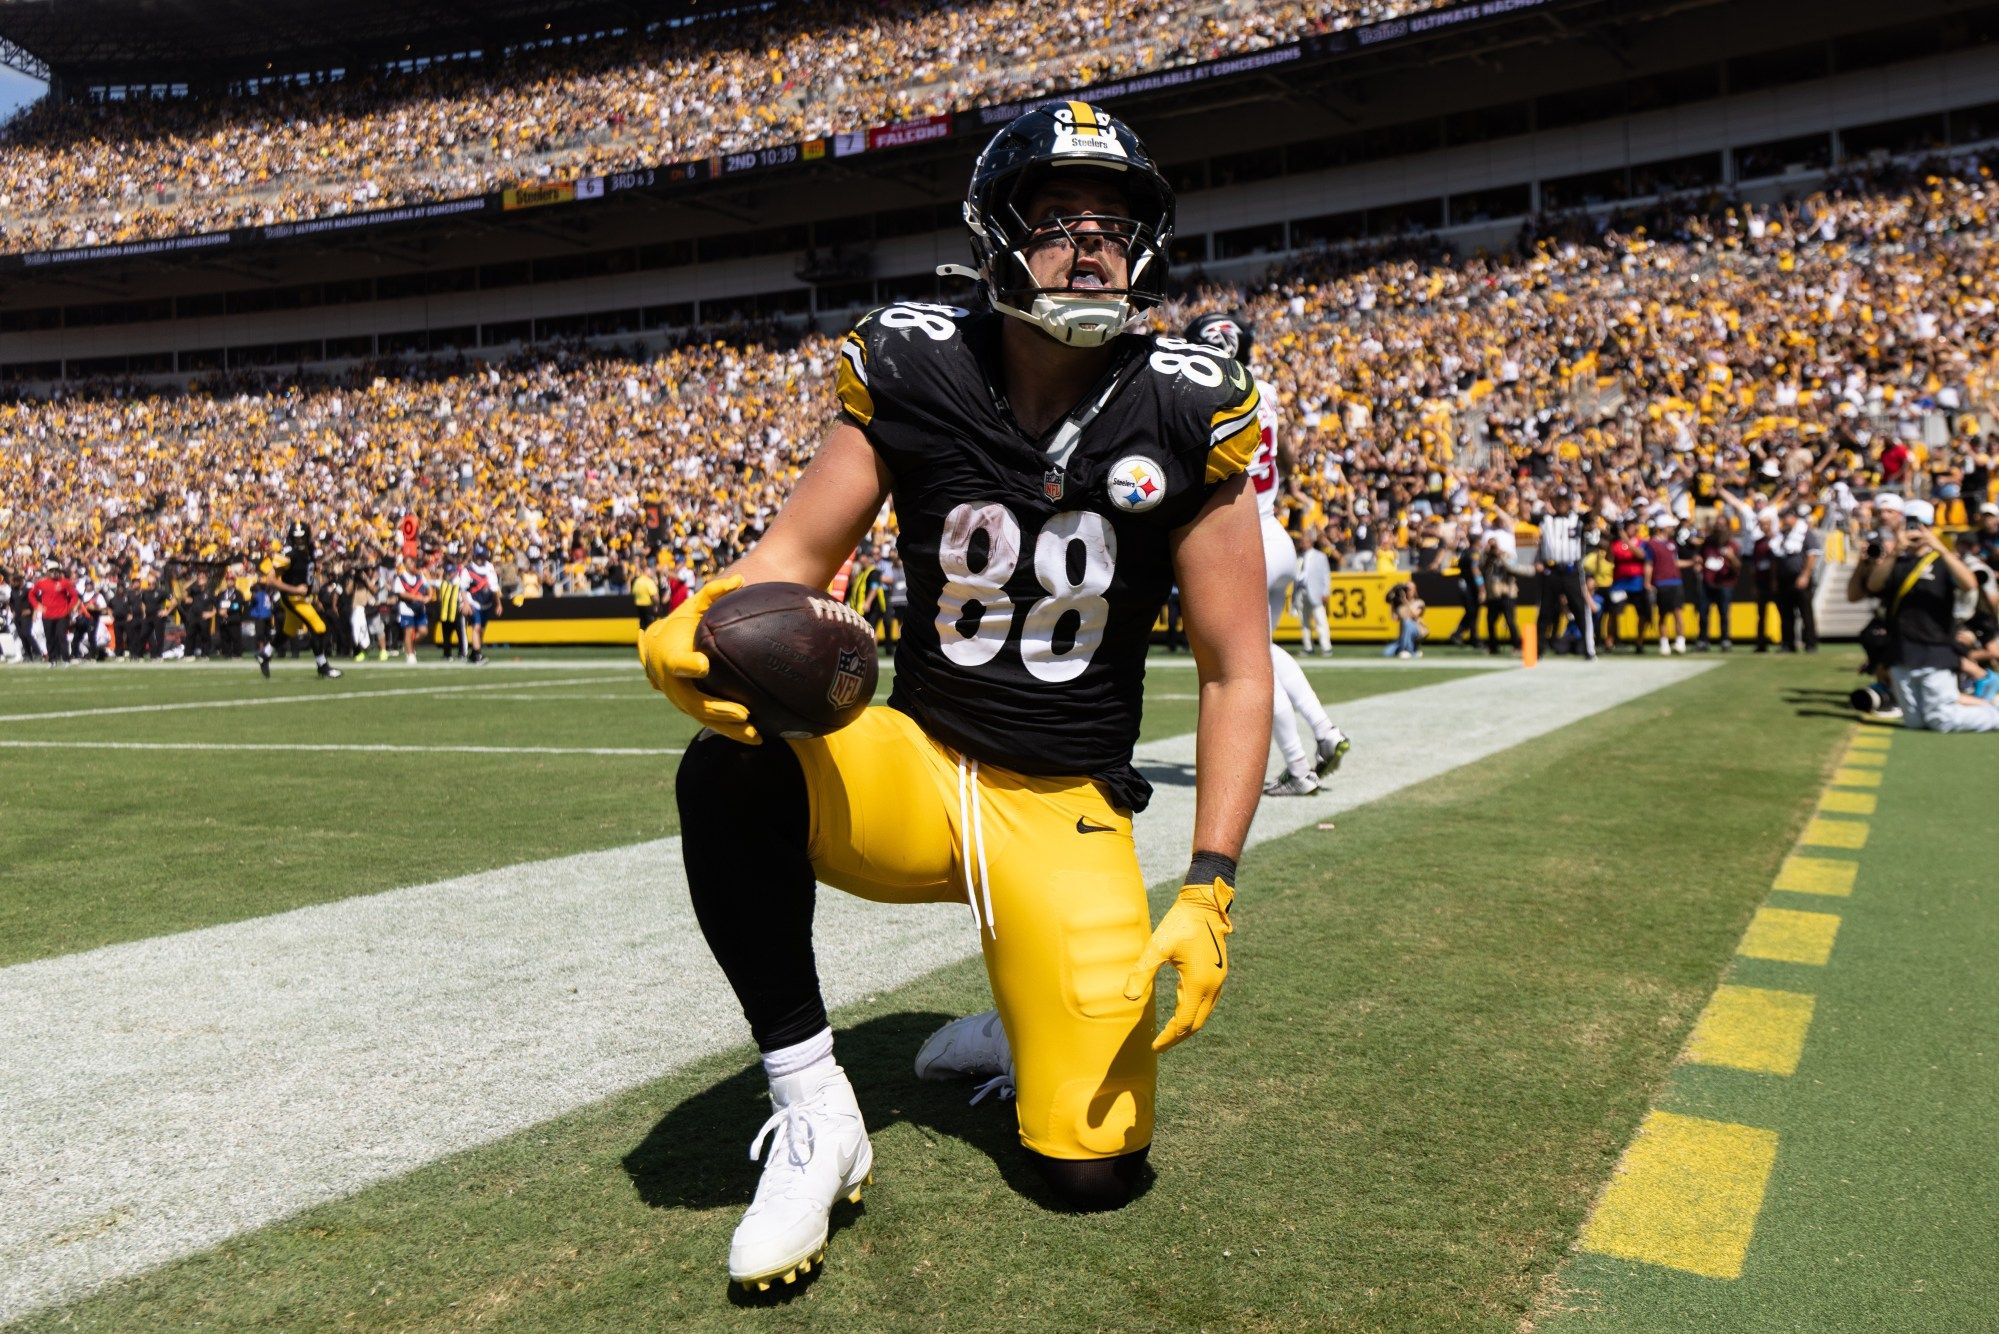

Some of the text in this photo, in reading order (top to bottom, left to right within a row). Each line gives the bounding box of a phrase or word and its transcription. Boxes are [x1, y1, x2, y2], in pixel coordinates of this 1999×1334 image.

[1410, 6, 1479, 32] ULTIMATE
[1128, 70, 1194, 93] AVAILABLE
[1196, 65, 1211, 79] AT
[1212, 48, 1301, 76] CONCESSIONS
[876, 123, 948, 148] FALCONS
[1071, 137, 1108, 149] Steelers
[727, 154, 756, 171] 2ND
[610, 175, 635, 192] 3RD
[295, 220, 333, 234] ULTIMATE
[369, 210, 413, 223] AVAILABLE
[415, 207, 425, 218] AT
[427, 199, 485, 217] CONCESSIONS
[123, 242, 165, 255] AVAILABLE
[176, 233, 230, 249] CONCESSIONS
[880, 301, 970, 341] 88
[1149, 337, 1223, 387] 88
[1046, 483, 1061, 497] NFL
[1113, 477, 1135, 488] Steelers
[934, 502, 1117, 682] 88
[1325, 588, 1367, 619] 33
[832, 671, 862, 703] NFL
